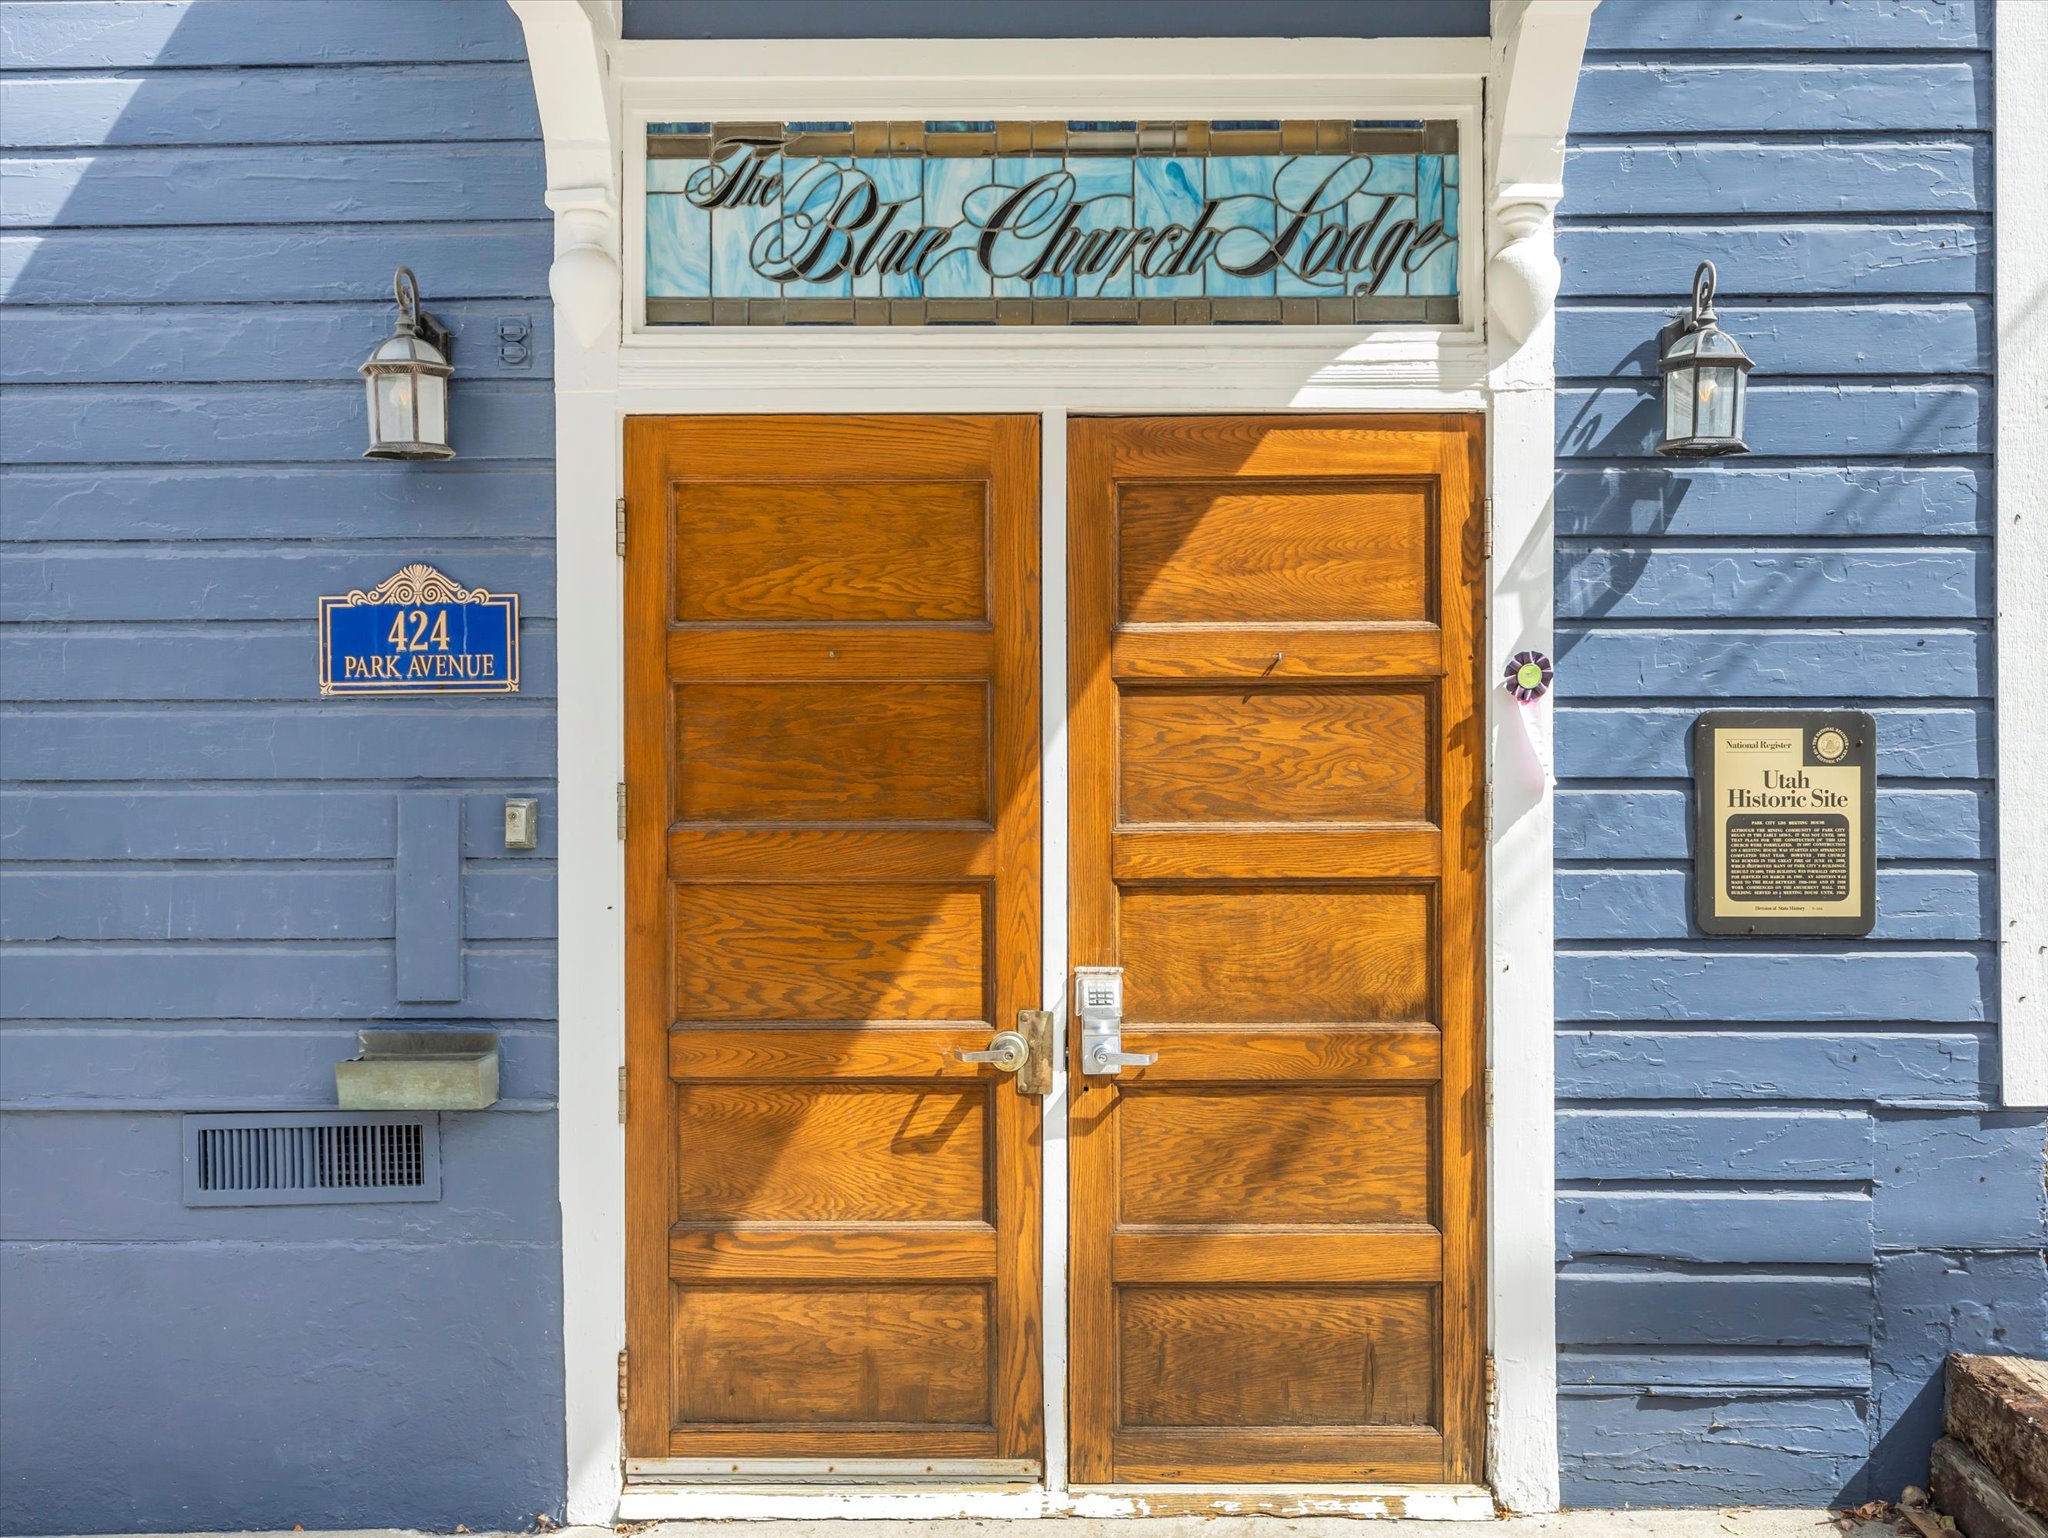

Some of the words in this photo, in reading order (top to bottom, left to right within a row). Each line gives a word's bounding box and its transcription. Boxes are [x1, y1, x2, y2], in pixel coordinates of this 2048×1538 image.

[685, 136, 785, 209] The
[749, 157, 951, 283] Blue
[961, 170, 1218, 281] Church
[1214, 155, 1450, 296] Lodge
[387, 610, 450, 652] 424
[344, 655, 401, 678] PARK
[407, 654, 495, 678] AVENUE
[1726, 740, 1759, 749] National
[1760, 740, 1793, 751] Register
[1762, 770, 1811, 789] Utah
[1727, 788, 1807, 808] Historic
[1811, 788, 1849, 808] Site
